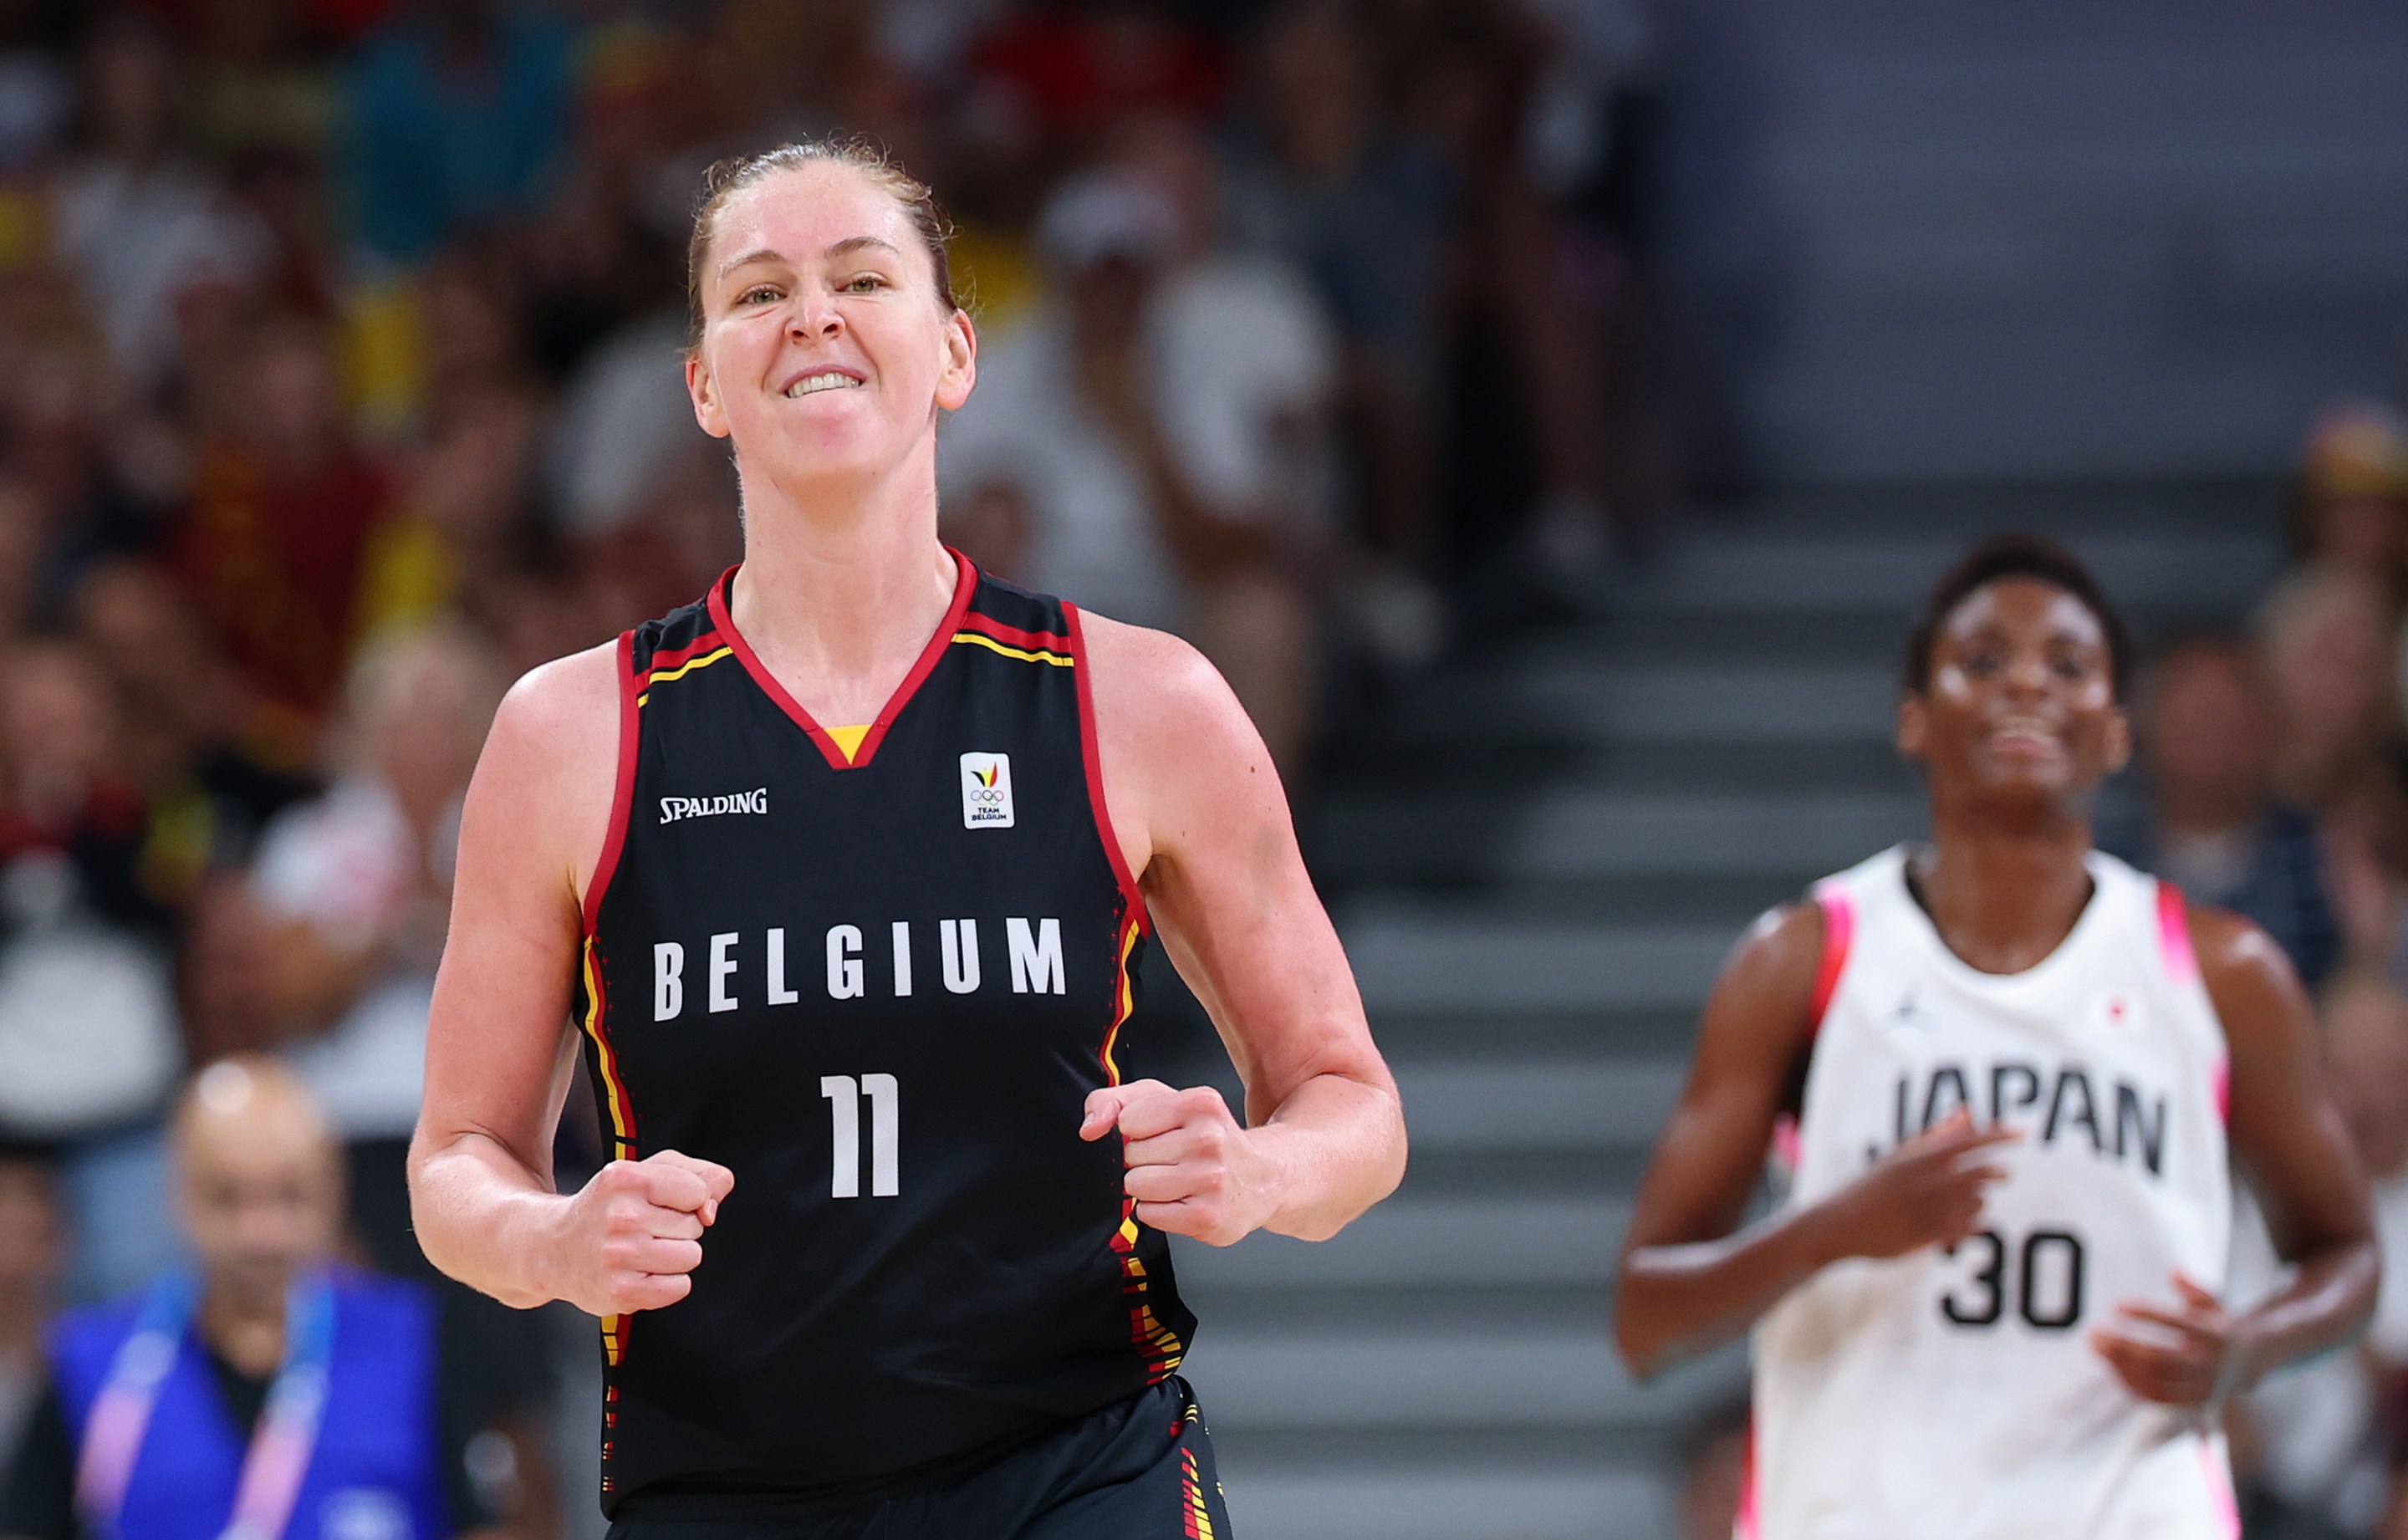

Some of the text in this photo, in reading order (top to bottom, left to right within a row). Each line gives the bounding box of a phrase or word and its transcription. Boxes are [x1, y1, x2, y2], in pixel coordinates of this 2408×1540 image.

[660, 788, 767, 824] SPALDING
[654, 917, 1066, 1022] BELGIUM
[820, 1073, 900, 1199] 11
[1865, 1063, 2166, 1175] JAPAN
[1941, 1230, 2084, 1328] 30
